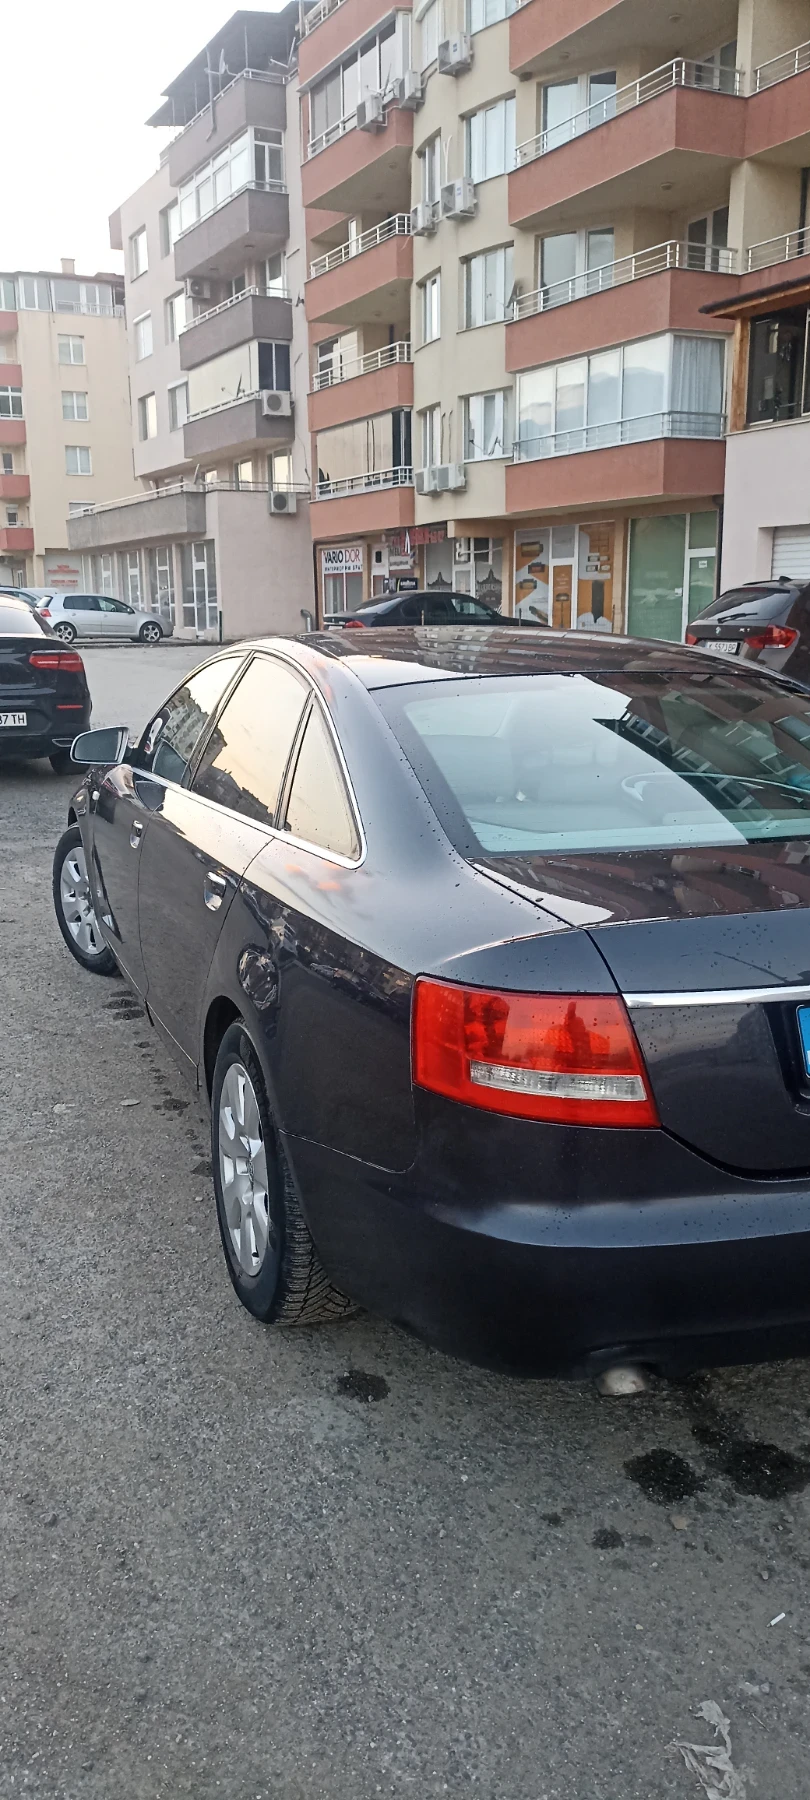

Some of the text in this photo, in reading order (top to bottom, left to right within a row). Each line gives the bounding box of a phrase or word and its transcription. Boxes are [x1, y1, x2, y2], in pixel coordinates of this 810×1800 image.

[323, 549, 361, 564] VARIO DOR
[11, 714, 25, 725] TH
